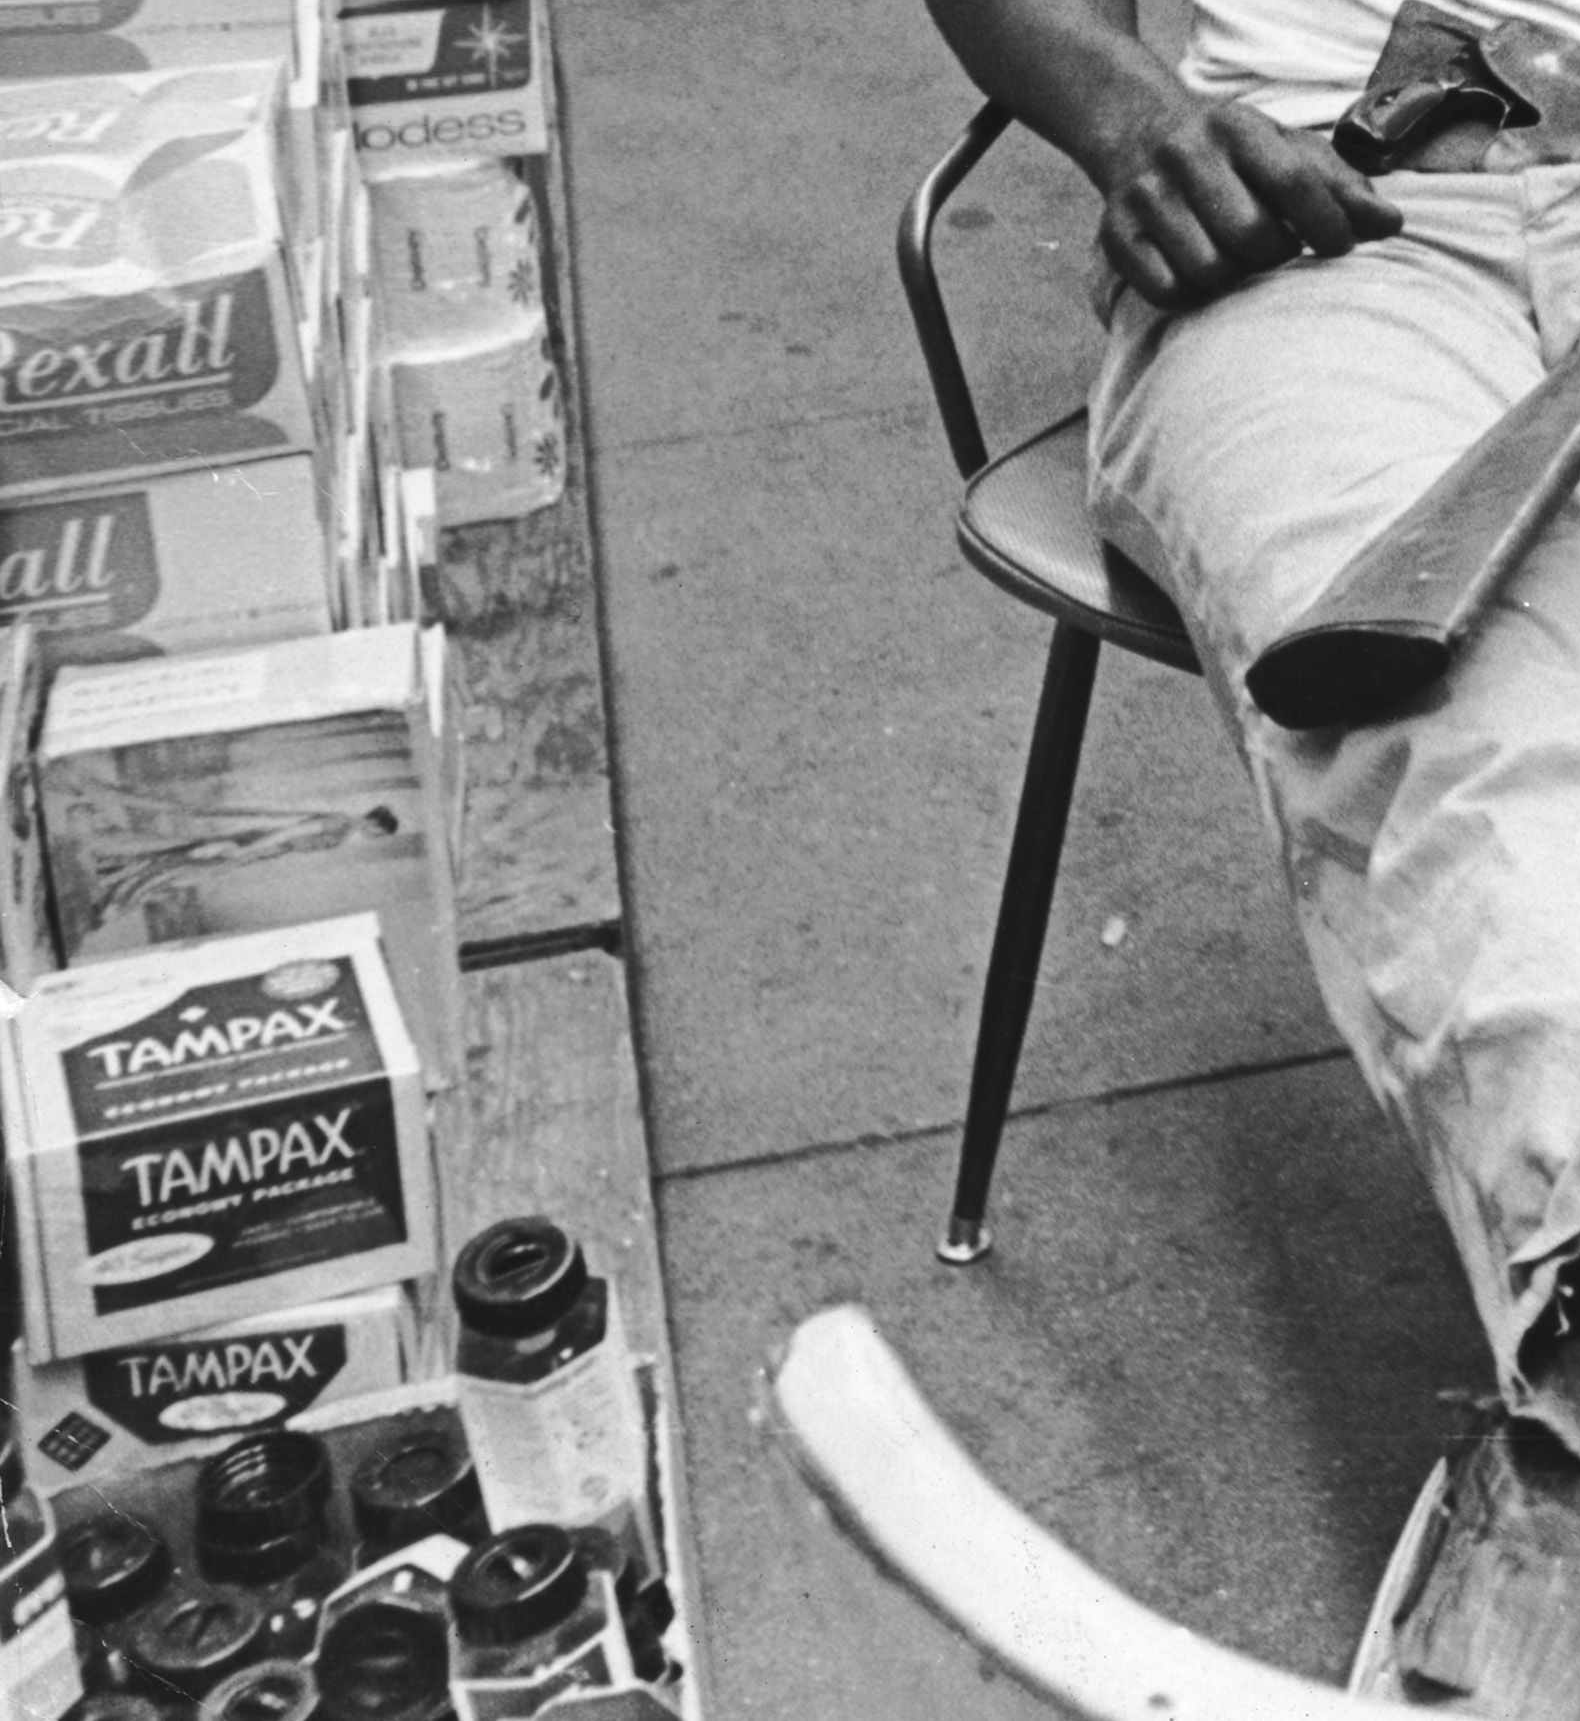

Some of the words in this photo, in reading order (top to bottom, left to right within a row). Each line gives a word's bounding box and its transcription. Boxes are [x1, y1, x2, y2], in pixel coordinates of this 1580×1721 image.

[0, 513, 117, 602] all
[86, 996, 346, 1078] TAMPAX
[121, 1107, 355, 1208] TAMPAX
[131, 1193, 243, 1231] ECONOMY
[251, 1166, 355, 1203] PACKAGE
[118, 1333, 320, 1398] TAMPAX
